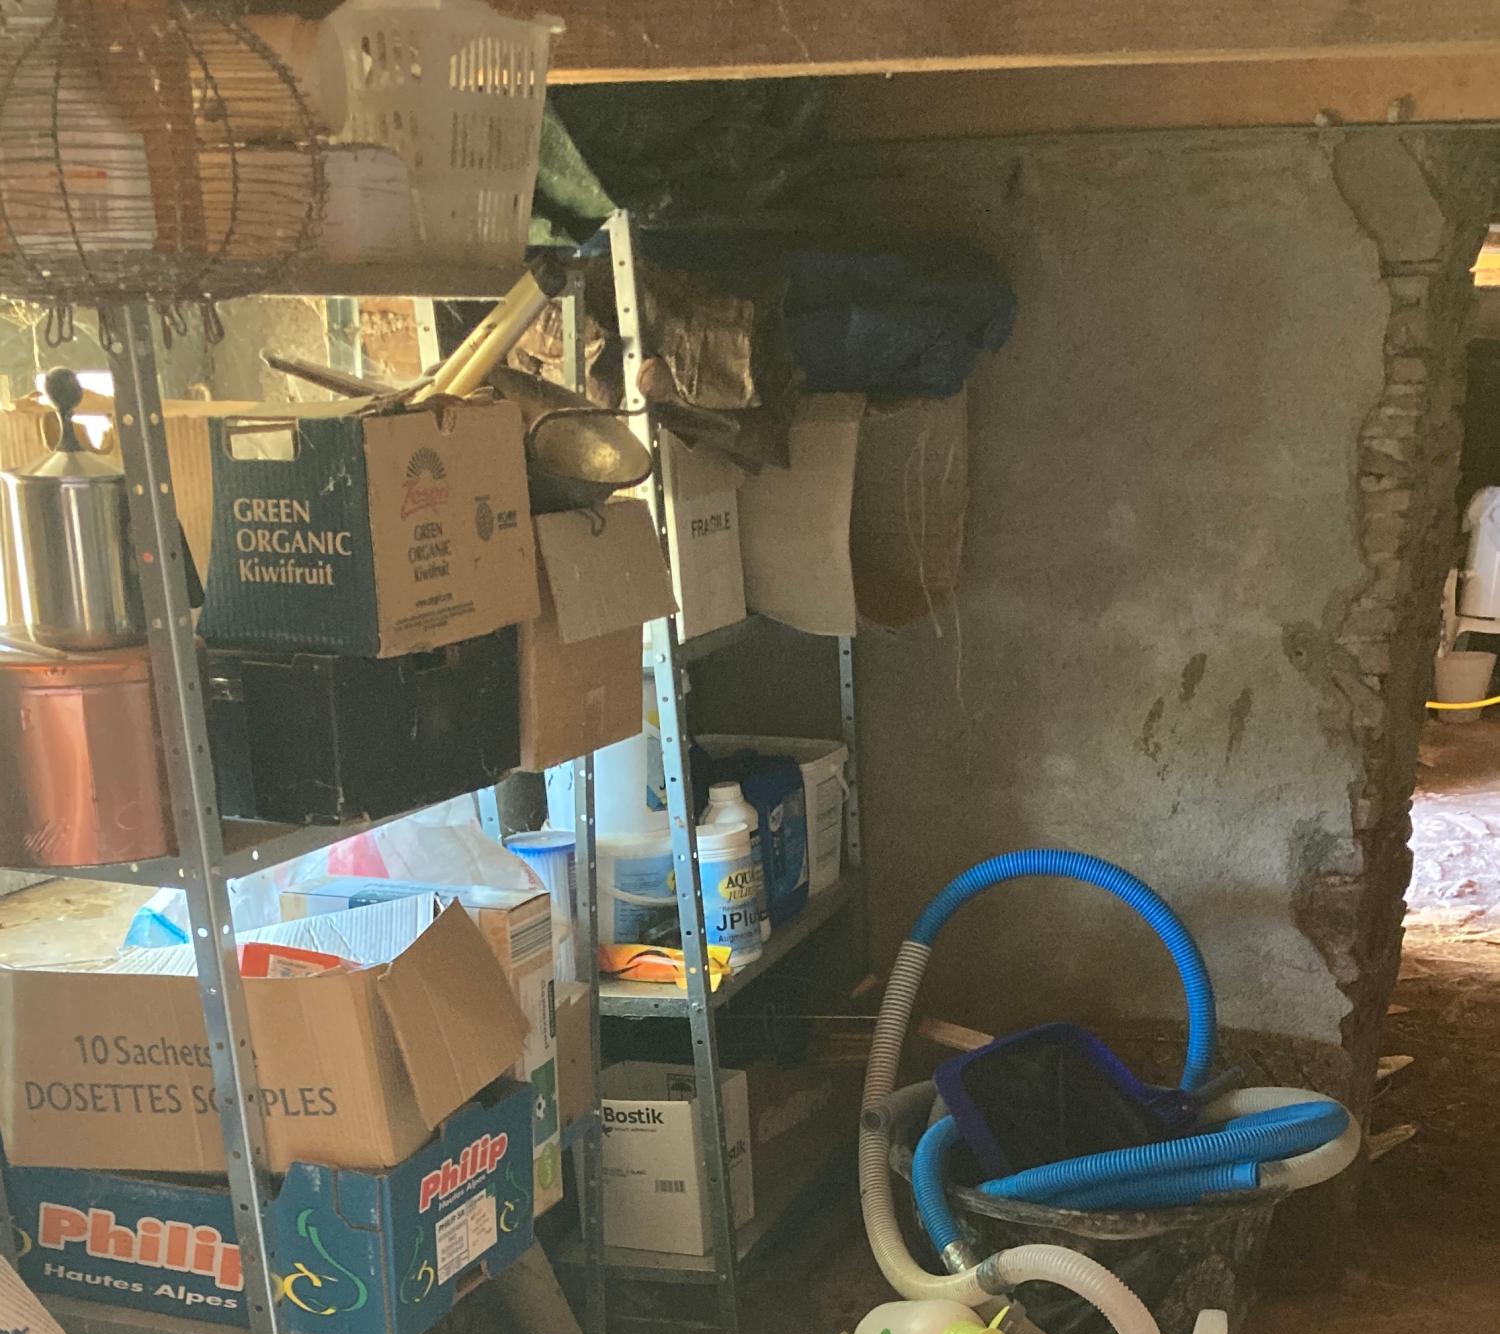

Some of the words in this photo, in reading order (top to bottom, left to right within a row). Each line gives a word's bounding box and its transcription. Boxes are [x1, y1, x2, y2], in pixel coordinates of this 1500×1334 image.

[233, 498, 311, 523] GREEN
[236, 528, 353, 556] ORGANIC
[240, 558, 335, 585] Kiwifruit
[73, 1035, 109, 1065] 10
[25, 1081, 182, 1113] DOSETTES
[192, 1085, 338, 1117] SPLES
[603, 1106, 664, 1125] Bostik
[419, 1132, 508, 1214] Philip
[43, 1263, 144, 1293] Hautes
[154, 1284, 238, 1309] Alpes
